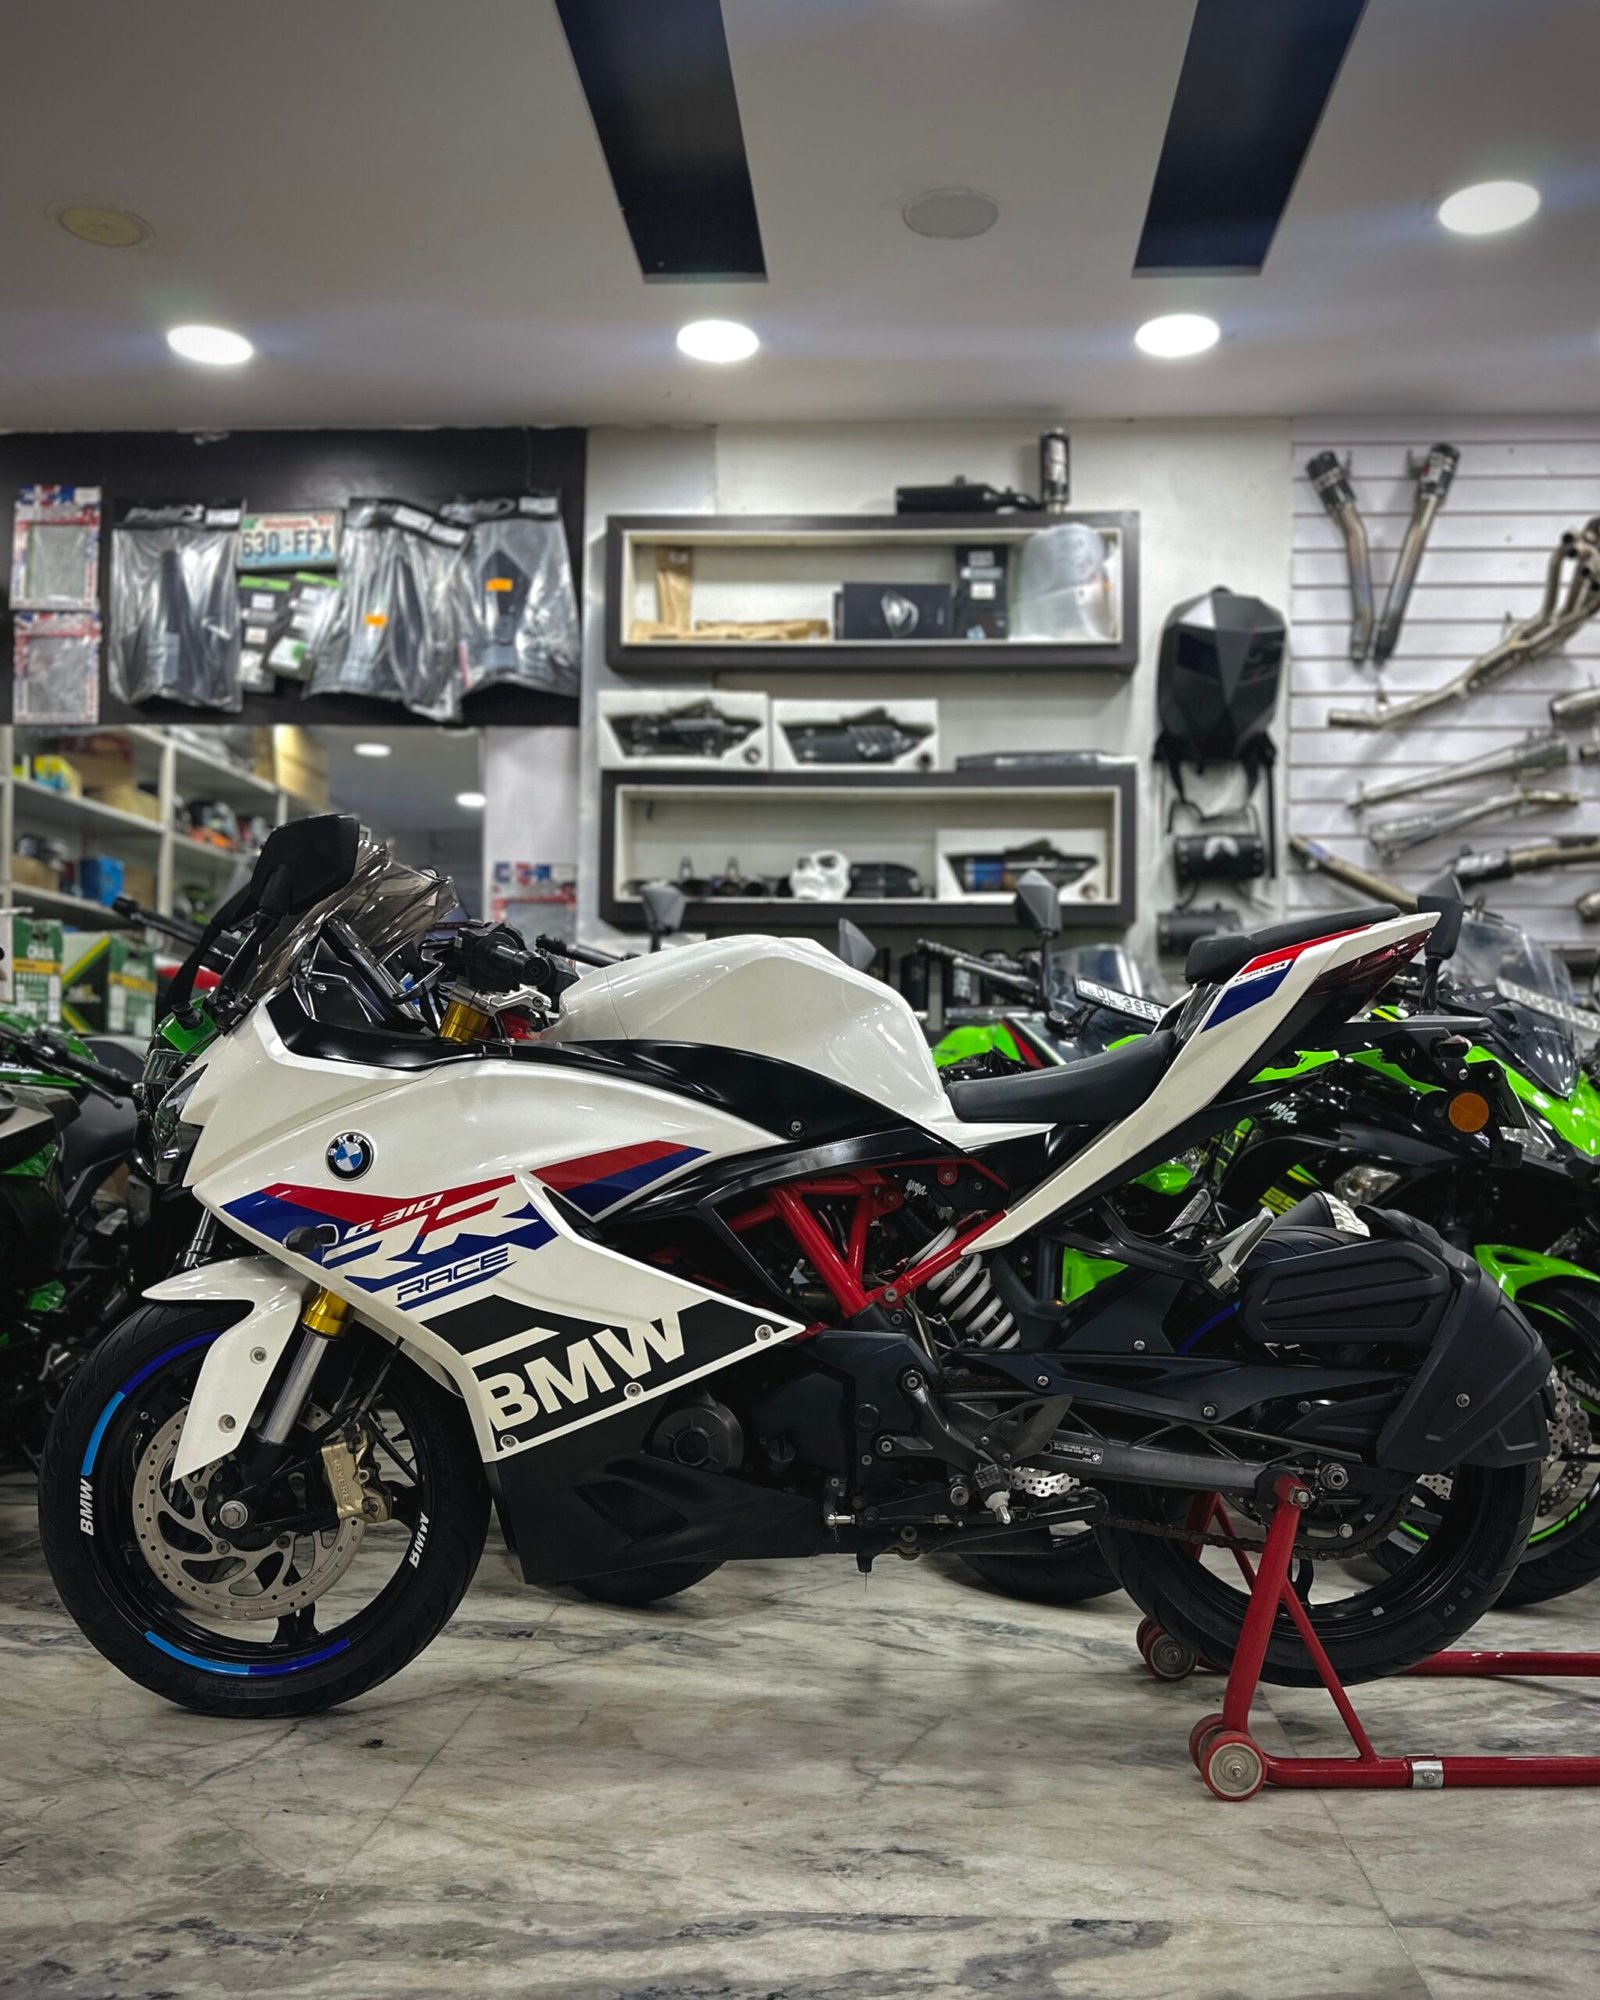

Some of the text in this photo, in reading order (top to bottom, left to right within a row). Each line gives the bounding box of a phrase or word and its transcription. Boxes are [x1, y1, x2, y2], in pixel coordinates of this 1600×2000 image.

[343, 1193, 445, 1240] G 310
[396, 1246, 508, 1301] RACE
[478, 1311, 685, 1432] BMW
[80, 1477, 95, 1536] BMW
[409, 1511, 429, 1569] BMW
